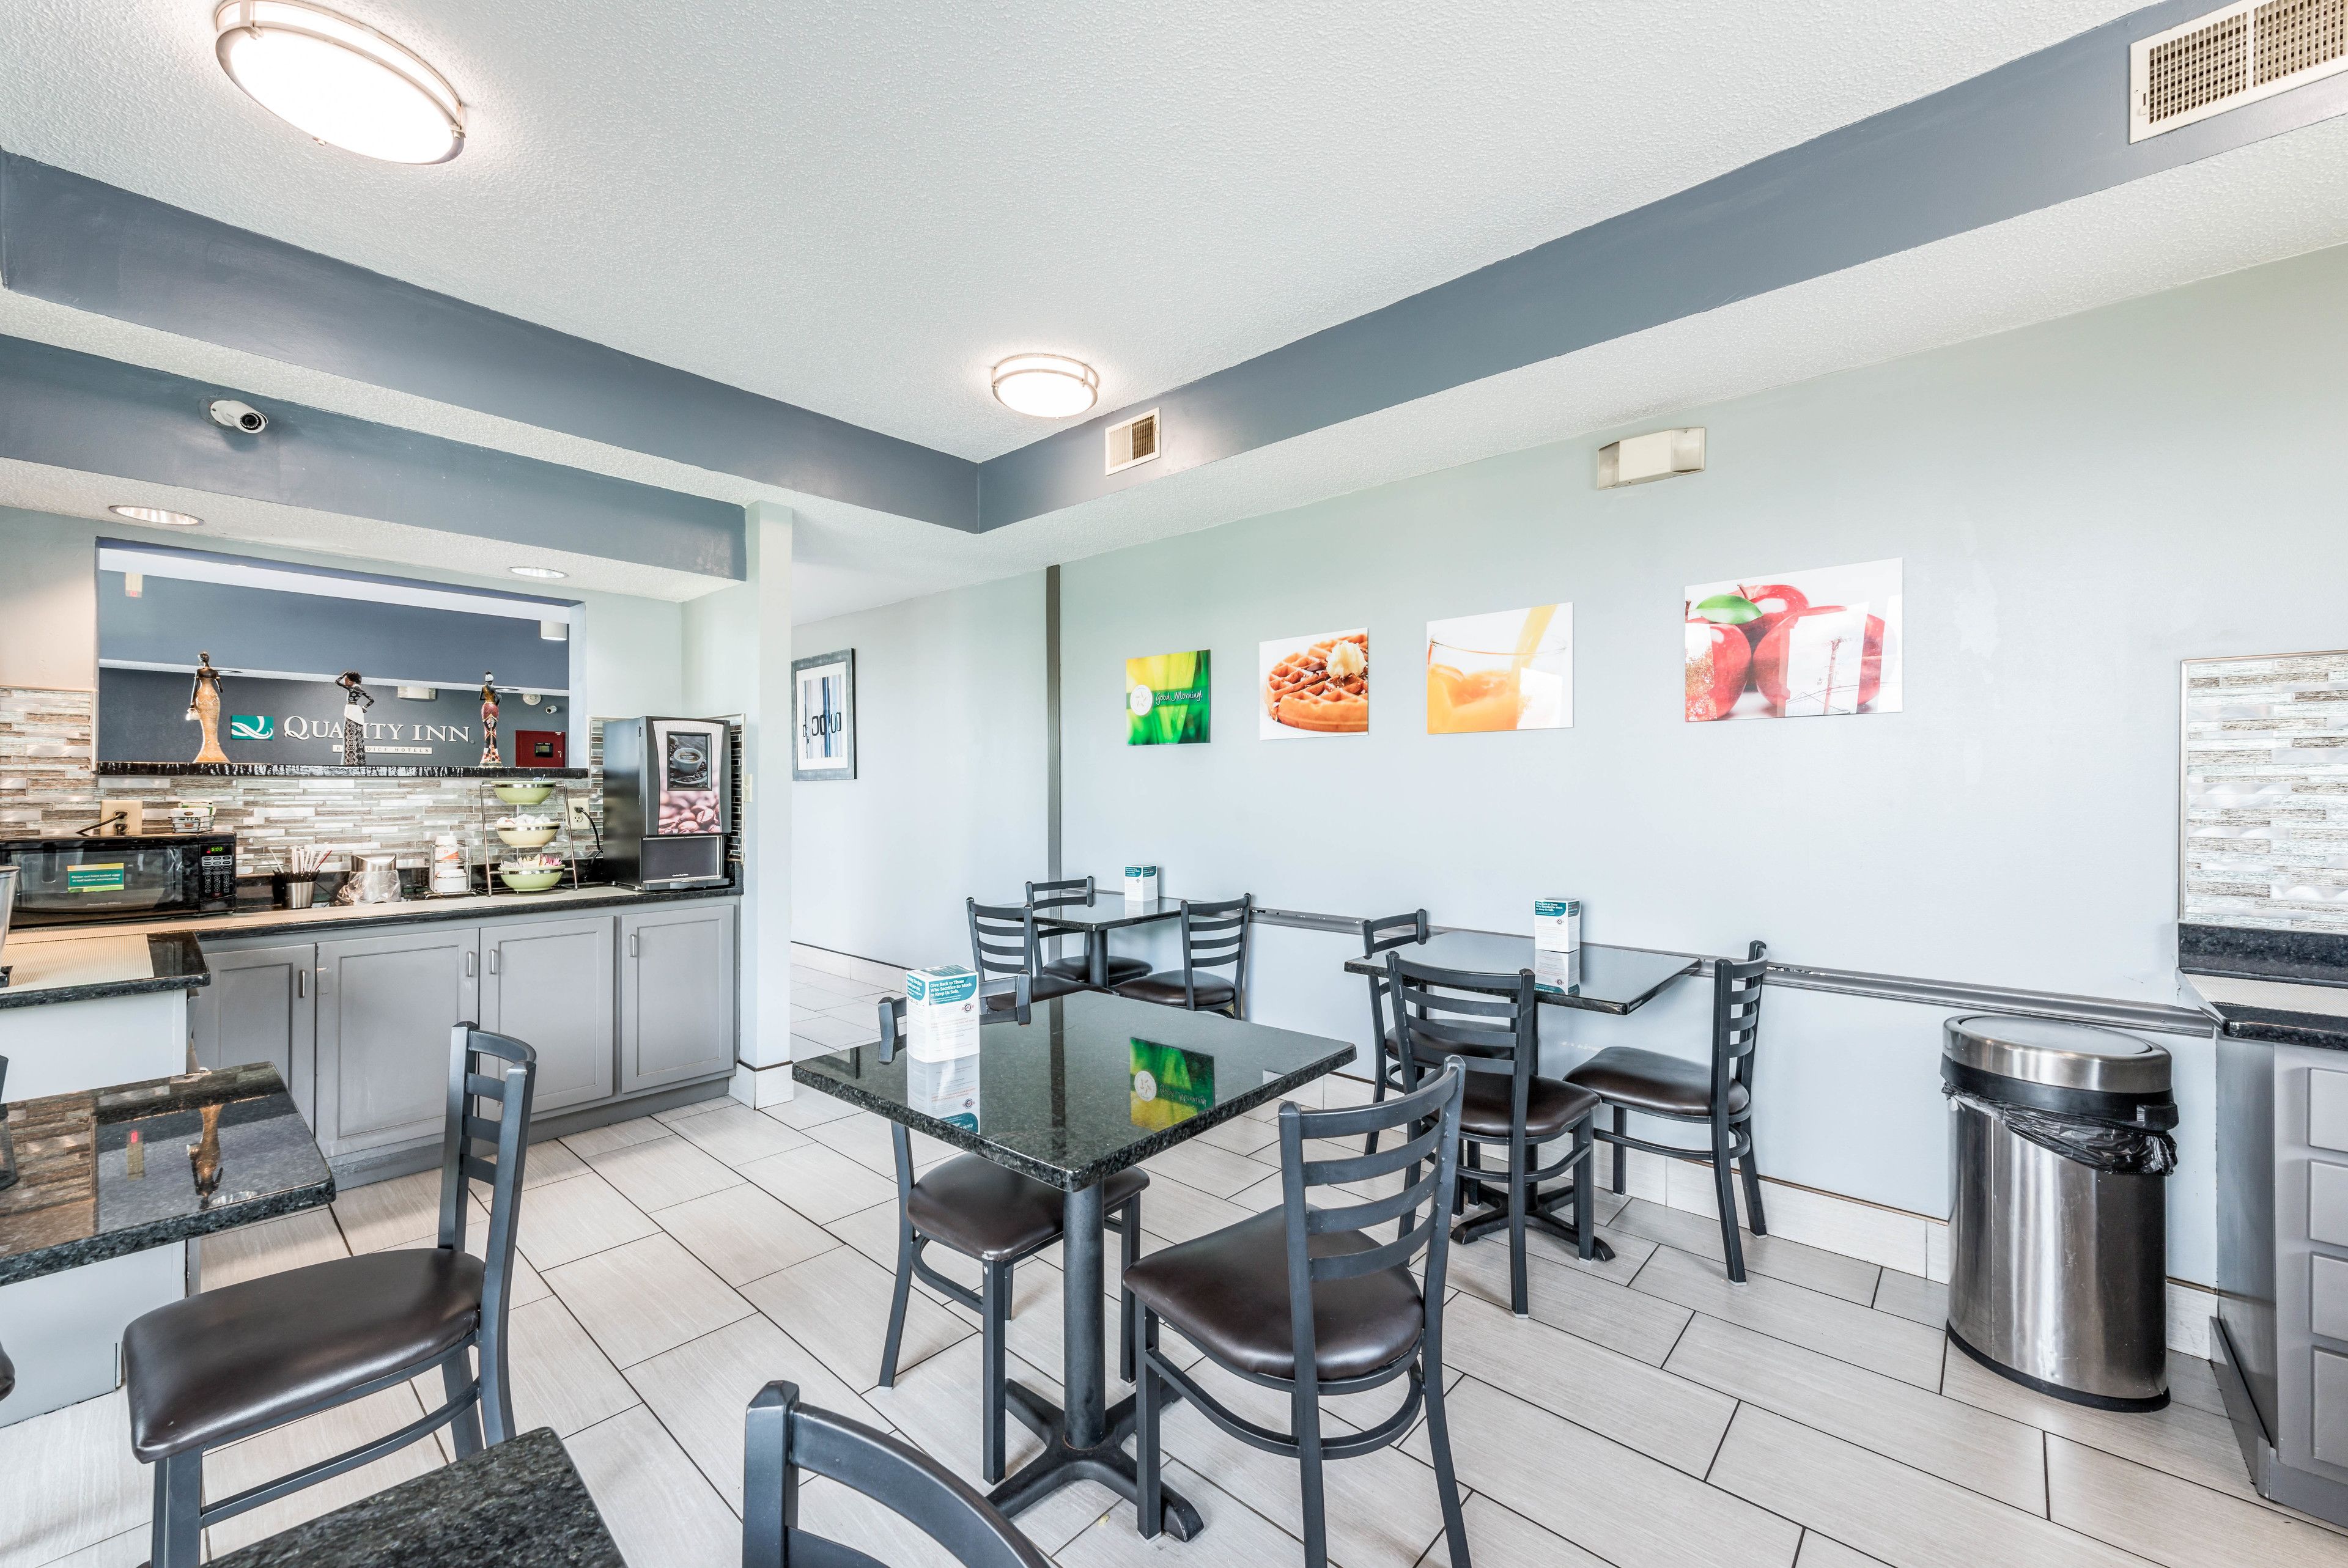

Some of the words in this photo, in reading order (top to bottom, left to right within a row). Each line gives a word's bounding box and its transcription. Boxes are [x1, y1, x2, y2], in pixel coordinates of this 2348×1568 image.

[1156, 692, 1170, 705] Good
[1171, 690, 1202, 701] Morning!
[284, 716, 404, 740] QUAITY
[412, 724, 470, 742] INN
